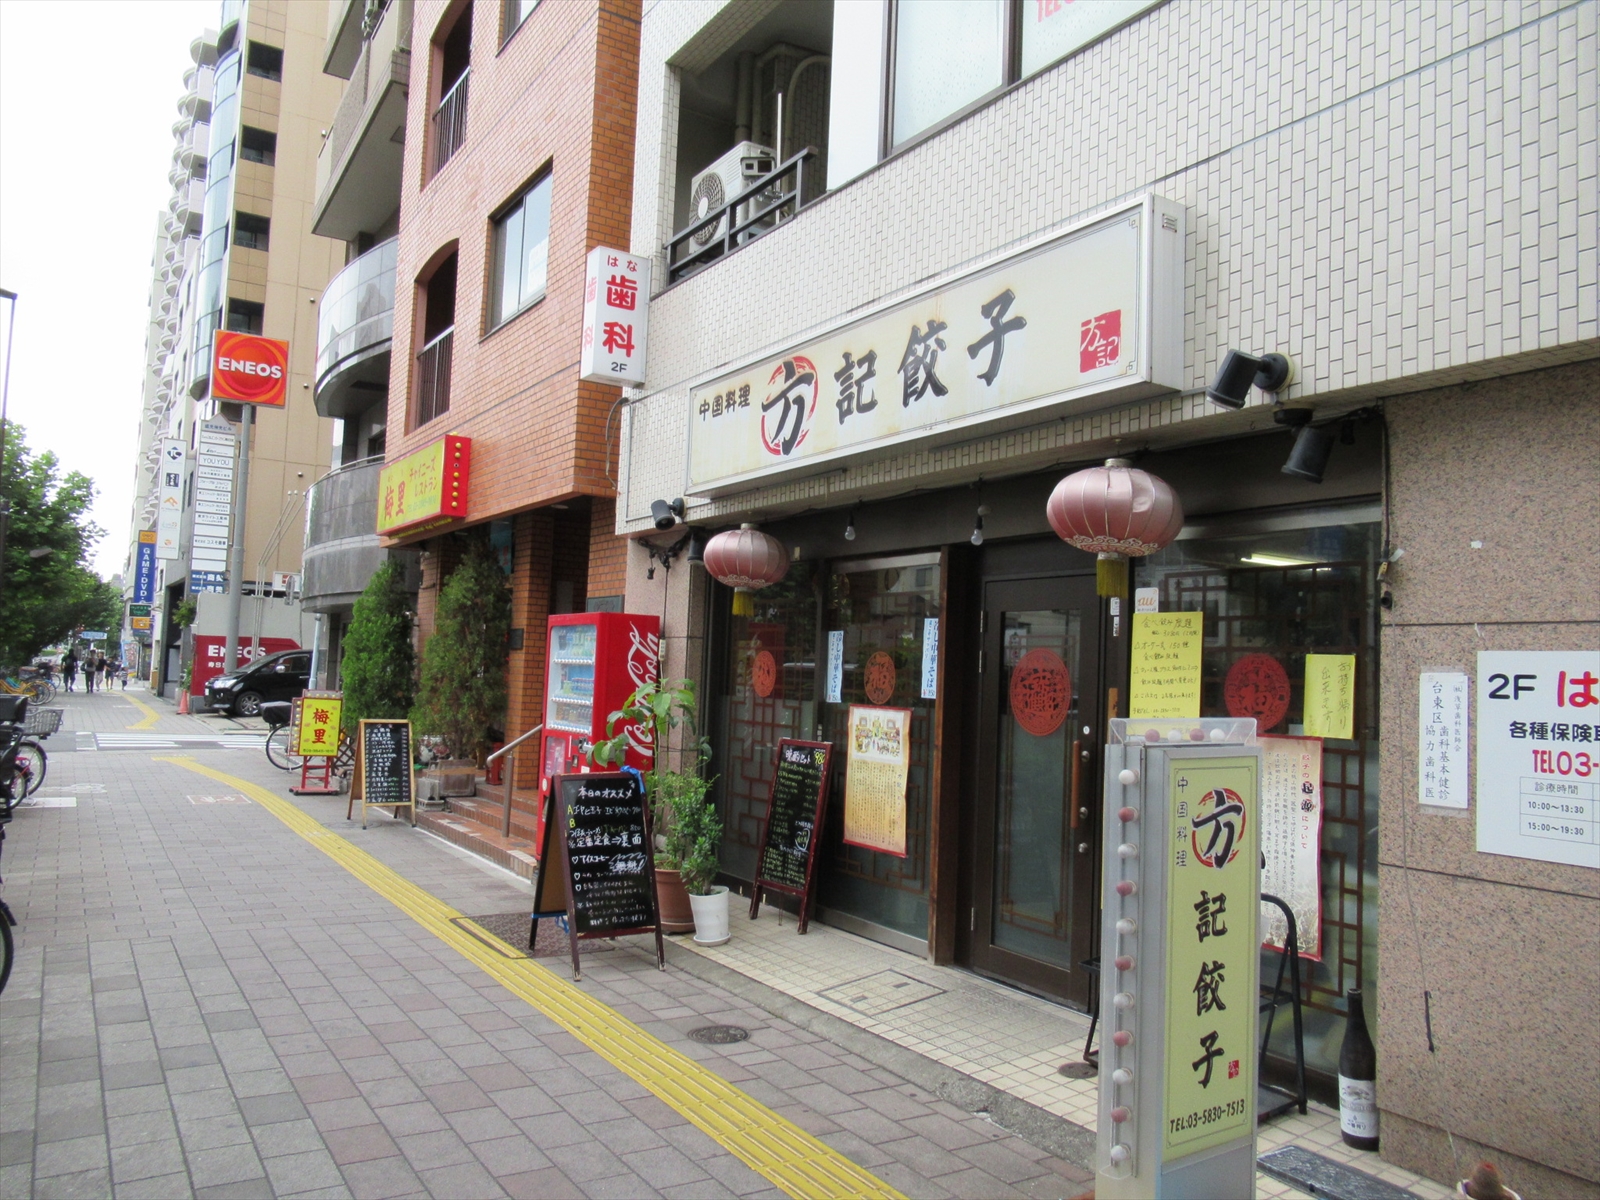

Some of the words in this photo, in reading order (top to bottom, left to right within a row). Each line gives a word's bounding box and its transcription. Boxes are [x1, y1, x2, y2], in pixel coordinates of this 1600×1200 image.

[607, 254, 638, 273] はな
[602, 274, 638, 358] 歯科
[218, 356, 282, 379] ENEOS
[611, 361, 628, 373] 2F
[698, 384, 751, 422] 中国料理
[1432, 681, 1444, 724] 台東区
[1488, 673, 1538, 700] 2F
[312, 708, 330, 745] 梅里
[1509, 720, 1600, 744] 各種保険
[1424, 724, 1436, 798] 協力歯科医
[1438, 725, 1451, 801] 歯科基本健診
[577, 785, 633, 800] 本日のオススメ
[1301, 754, 1315, 850] 餃子の起源について
[1535, 782, 1578, 796] 診療時間
[569, 818, 576, 828] B
[1176, 776, 1189, 867] 中国料理
[1170, 1099, 1245, 1134] TEL:03-5830-7513
